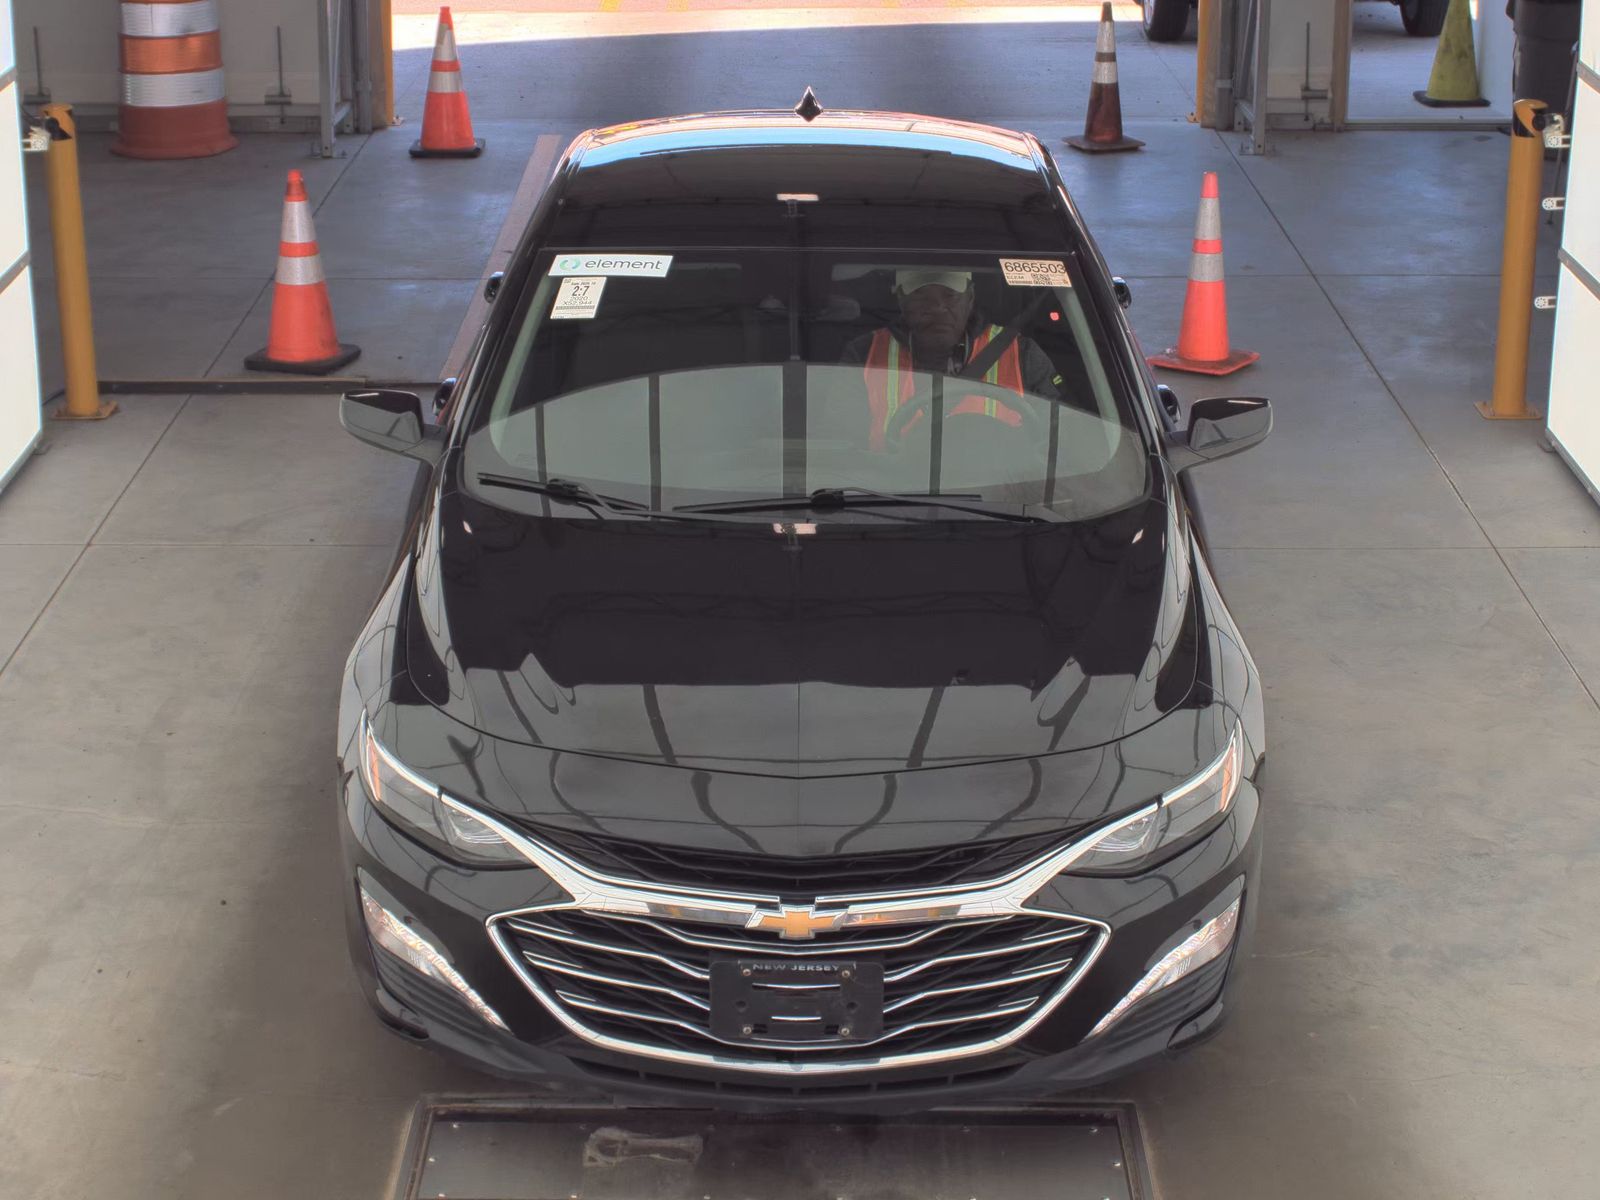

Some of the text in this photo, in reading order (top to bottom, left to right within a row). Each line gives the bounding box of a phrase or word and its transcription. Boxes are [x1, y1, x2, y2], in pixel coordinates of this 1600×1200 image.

[585, 259, 662, 269] element
[1004, 262, 1066, 274] 6865503
[572, 285, 590, 296] 2:7
[753, 963, 840, 972] NEW JERSEY
